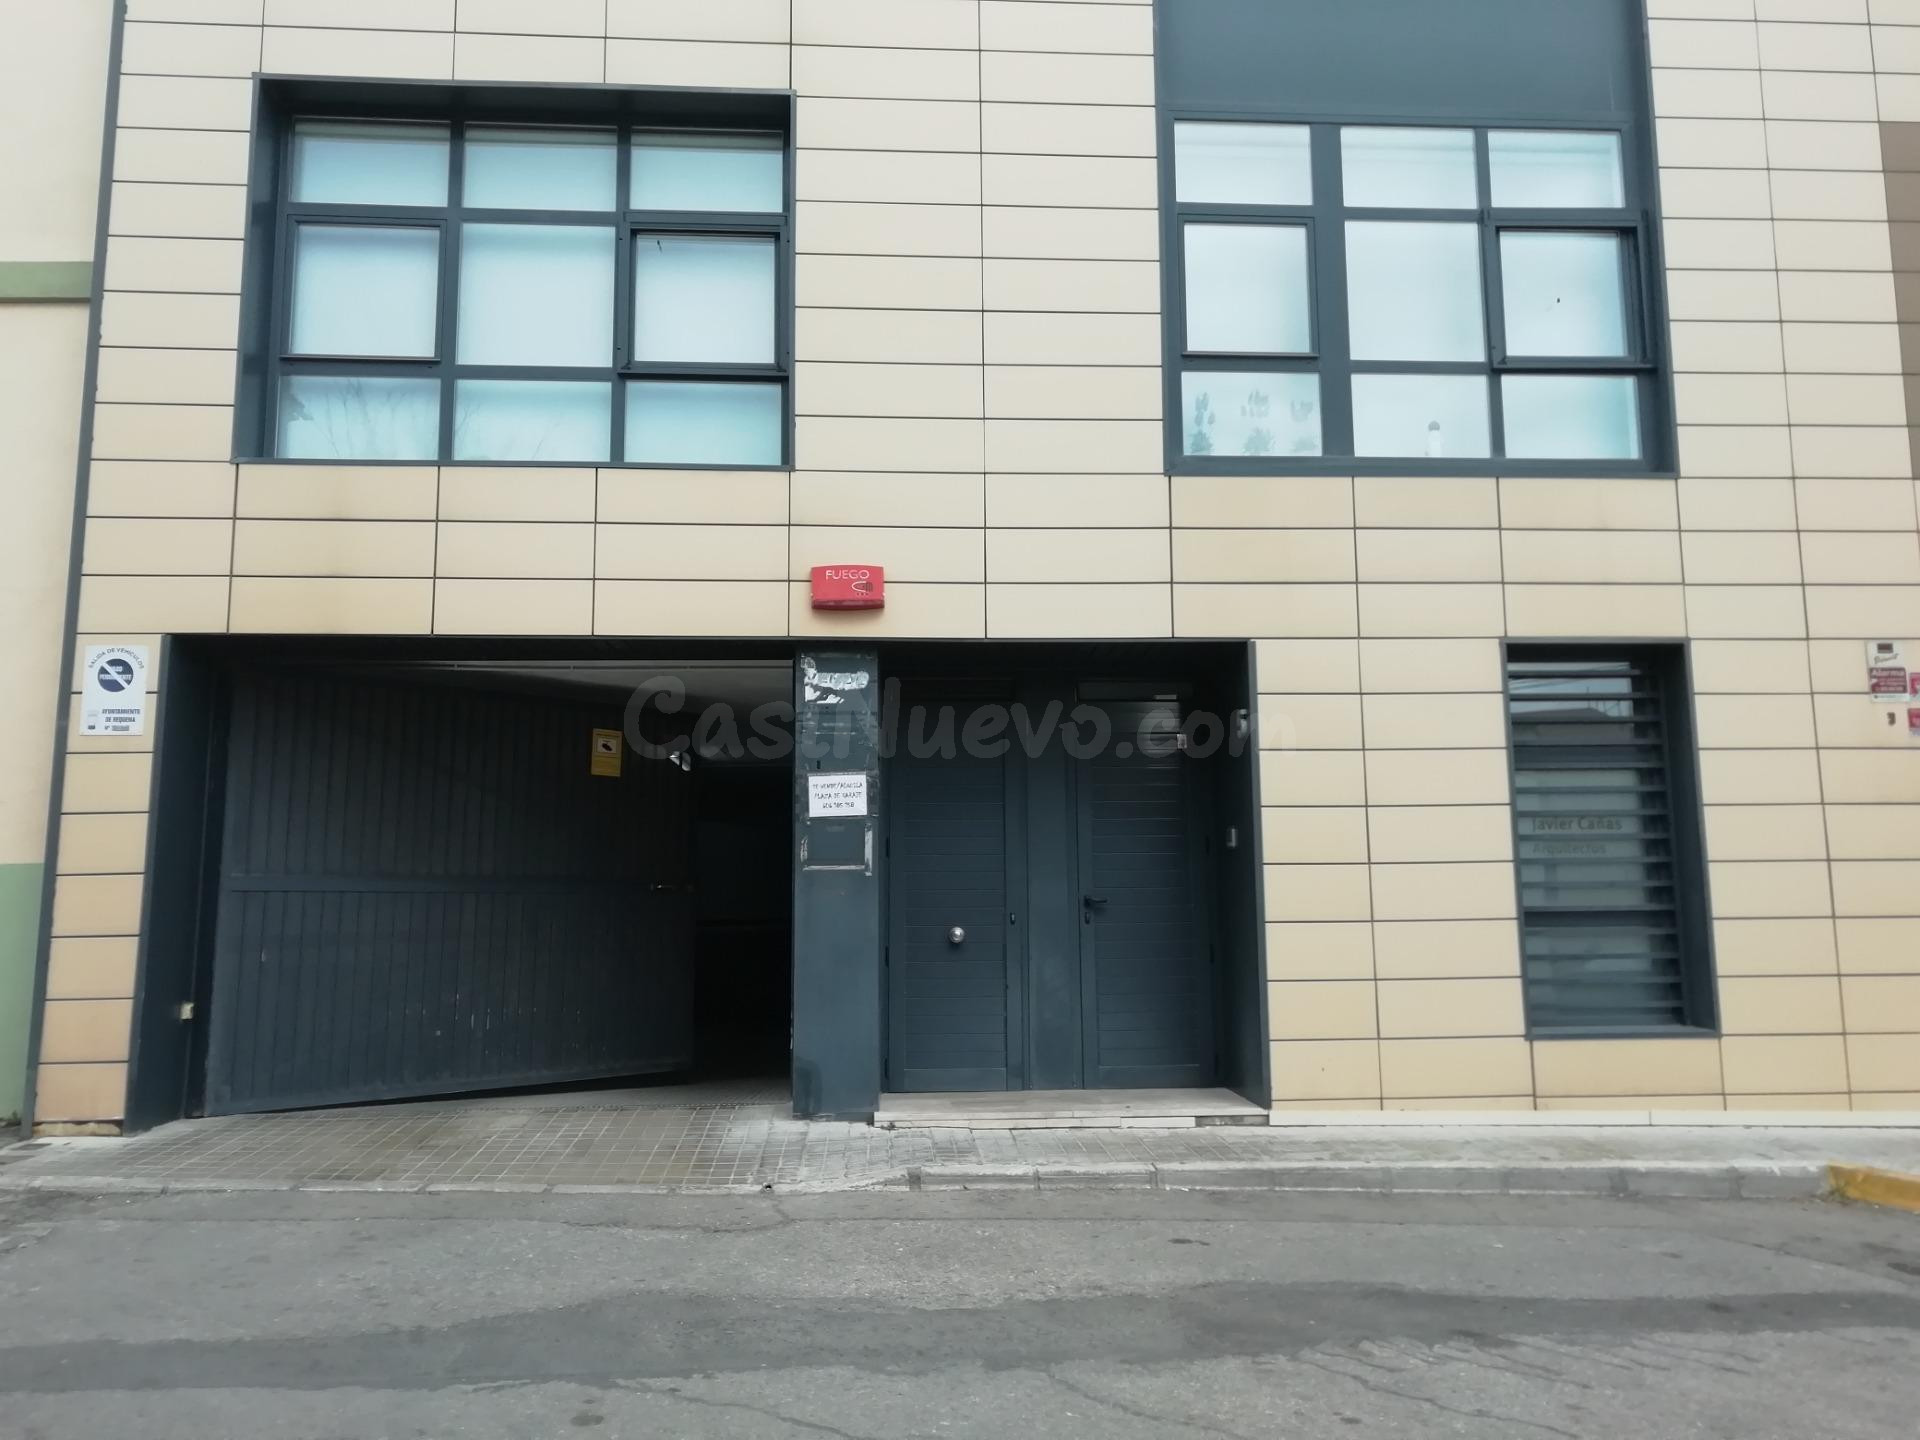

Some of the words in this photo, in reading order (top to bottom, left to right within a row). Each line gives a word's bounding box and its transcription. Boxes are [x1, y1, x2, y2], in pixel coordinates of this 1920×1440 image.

[825, 569, 870, 581] FUEGO
[106, 647, 116, 655] DE
[1532, 815, 1573, 833] Javier
